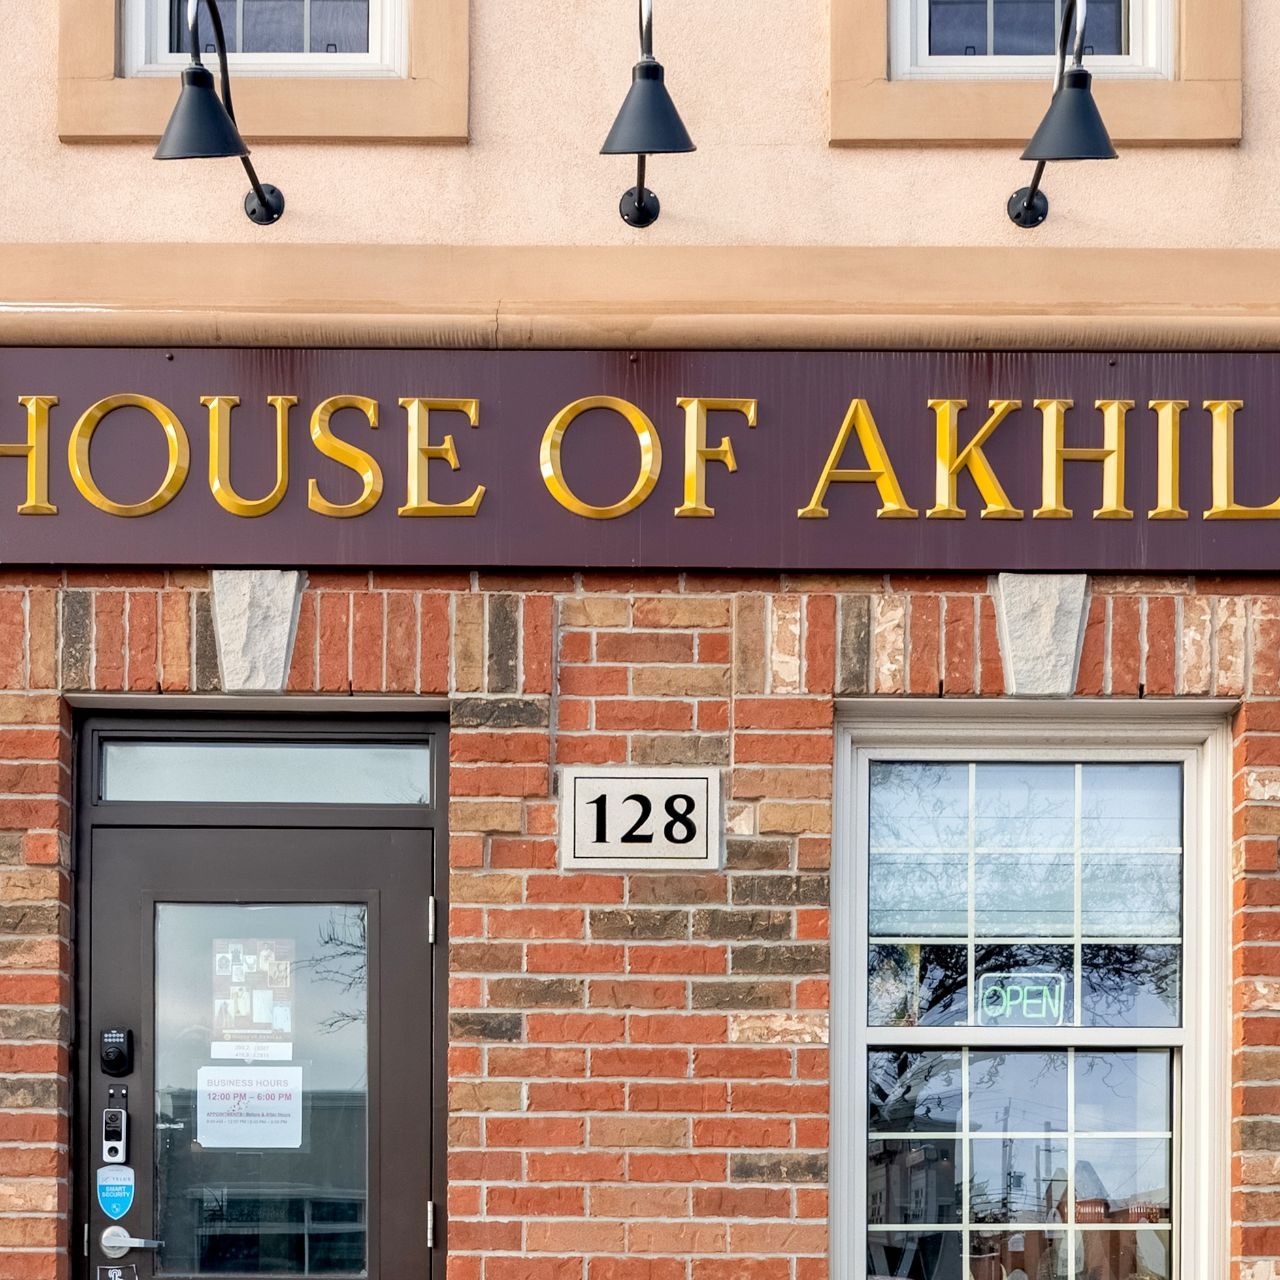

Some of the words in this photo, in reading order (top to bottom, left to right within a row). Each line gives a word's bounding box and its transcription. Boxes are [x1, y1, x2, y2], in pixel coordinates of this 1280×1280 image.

[538, 394, 758, 521] OF
[585, 793, 697, 845] 128
[982, 984, 1061, 1018] OPEN
[207, 1079, 253, 1087] BUSINESS
[256, 1079, 289, 1087] HOURS
[207, 1093, 231, 1101] 12:00
[233, 1093, 247, 1101] PM
[257, 1093, 276, 1101] 6:00
[278, 1093, 292, 1101] PM
